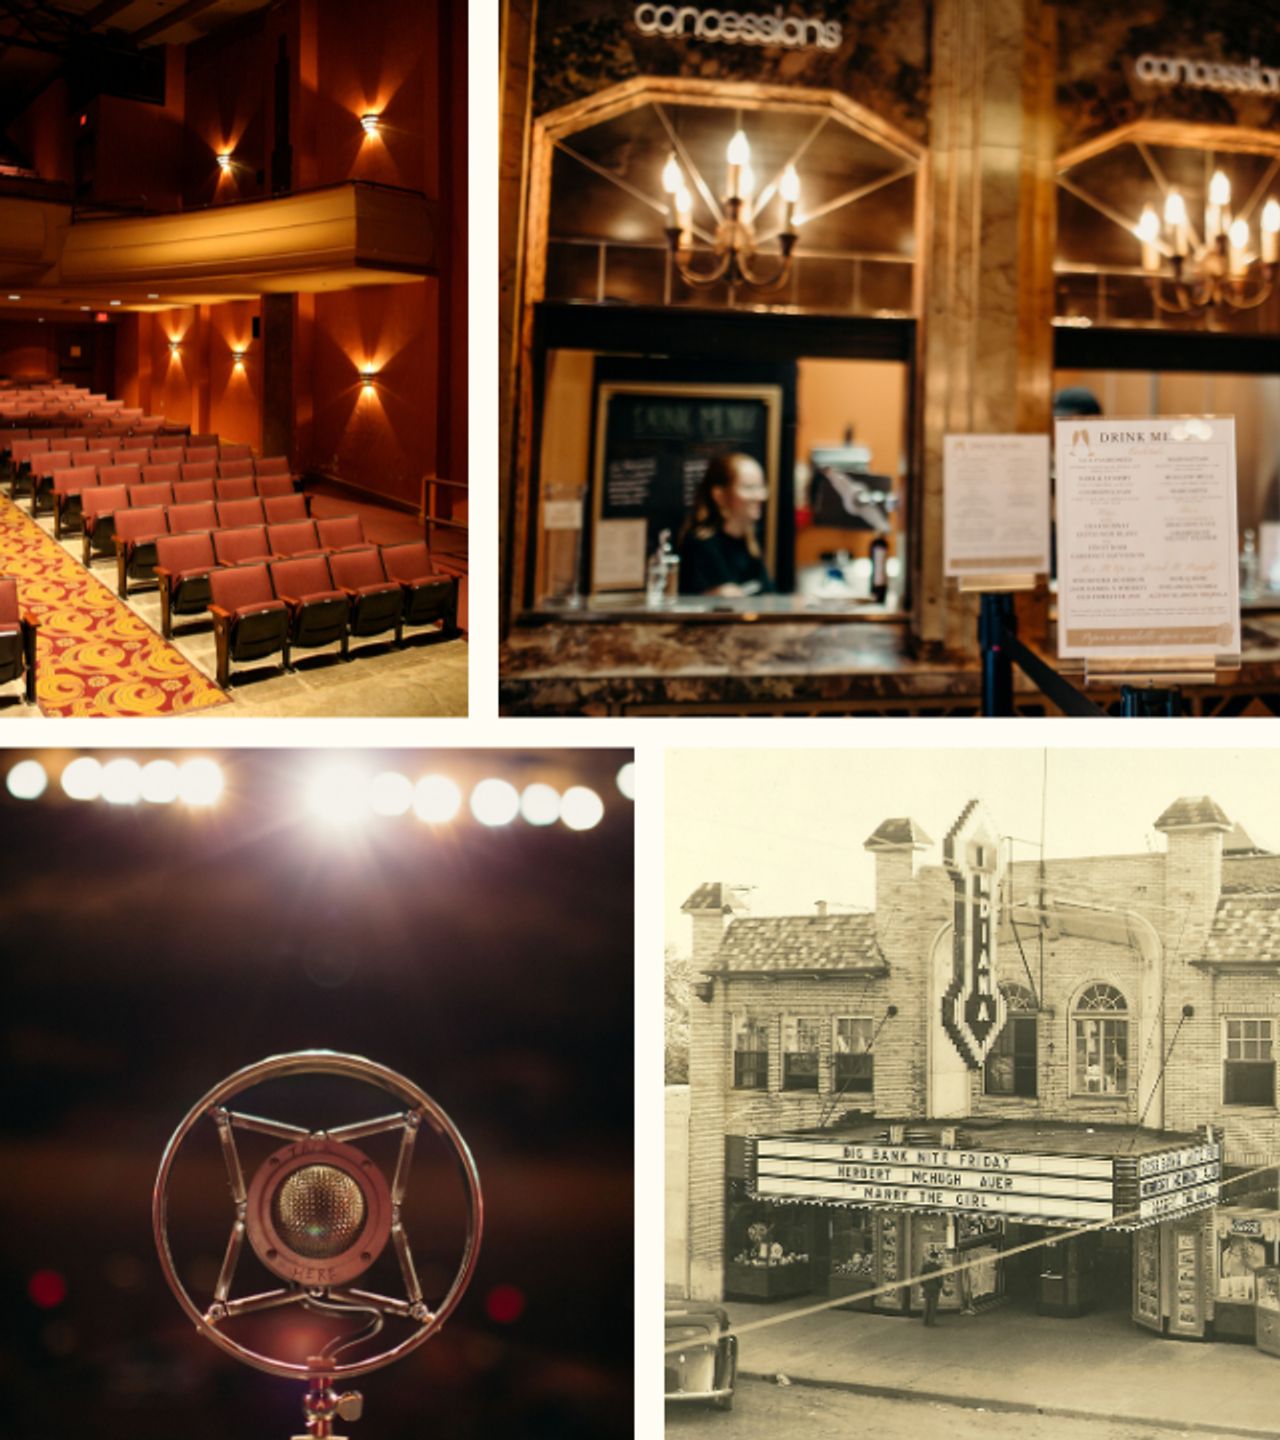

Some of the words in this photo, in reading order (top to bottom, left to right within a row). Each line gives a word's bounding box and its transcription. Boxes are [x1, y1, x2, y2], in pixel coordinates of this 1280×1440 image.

[634, 3, 843, 49] concessions
[1100, 432, 1146, 444] DRINK
[872, 1147, 908, 1163] BANK
[917, 1151, 949, 1166] NITE
[959, 1154, 1012, 1169] FRIDAY
[838, 1166, 891, 1180] HERBERT
[979, 1177, 1014, 1190] AUER
[919, 1190, 944, 1204] THE
[294, 1267, 337, 1281] HERE
